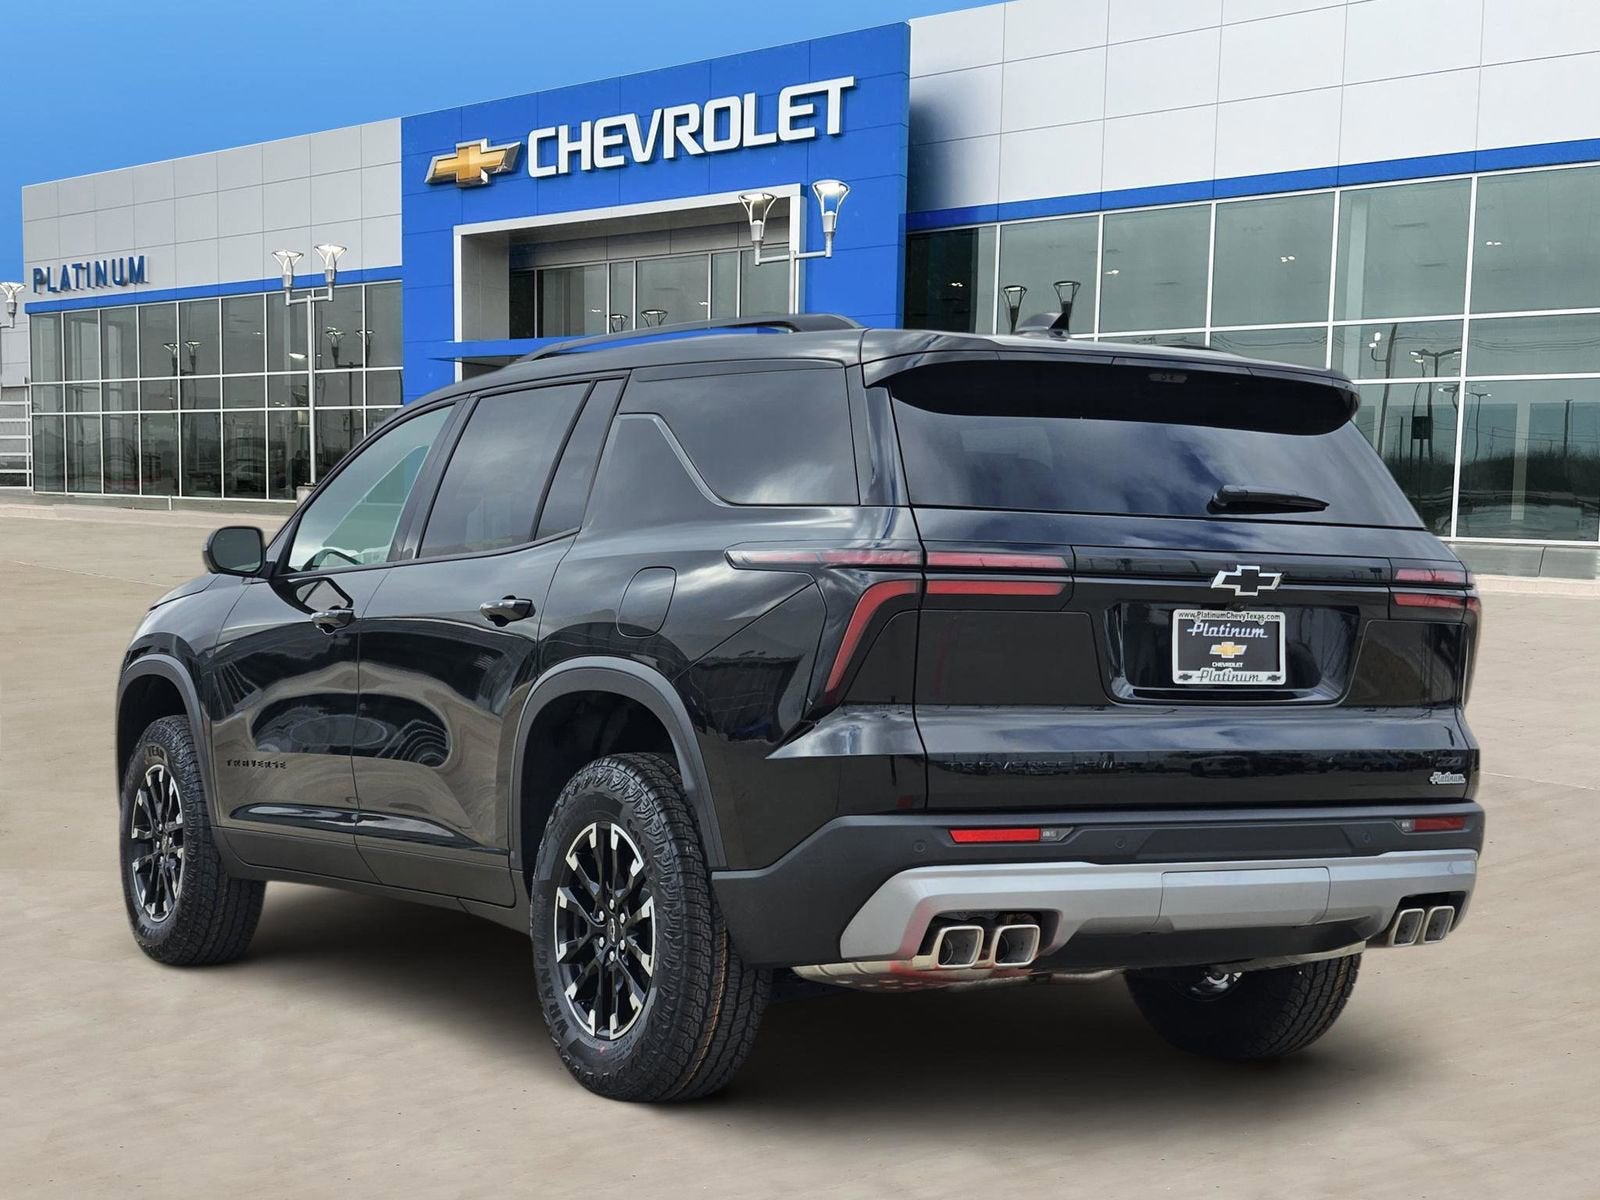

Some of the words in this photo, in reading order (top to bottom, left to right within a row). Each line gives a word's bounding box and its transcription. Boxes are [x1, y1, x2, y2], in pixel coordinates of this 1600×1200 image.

[527, 75, 856, 178] CHEVROLET
[33, 254, 147, 294] PLATINUM
[1178, 610, 1281, 621] www.PlatinumChevyTexas.com
[1187, 622, 1269, 638] Platinum
[1195, 669, 1263, 683] Platinum
[1430, 771, 1466, 785] Platinum
